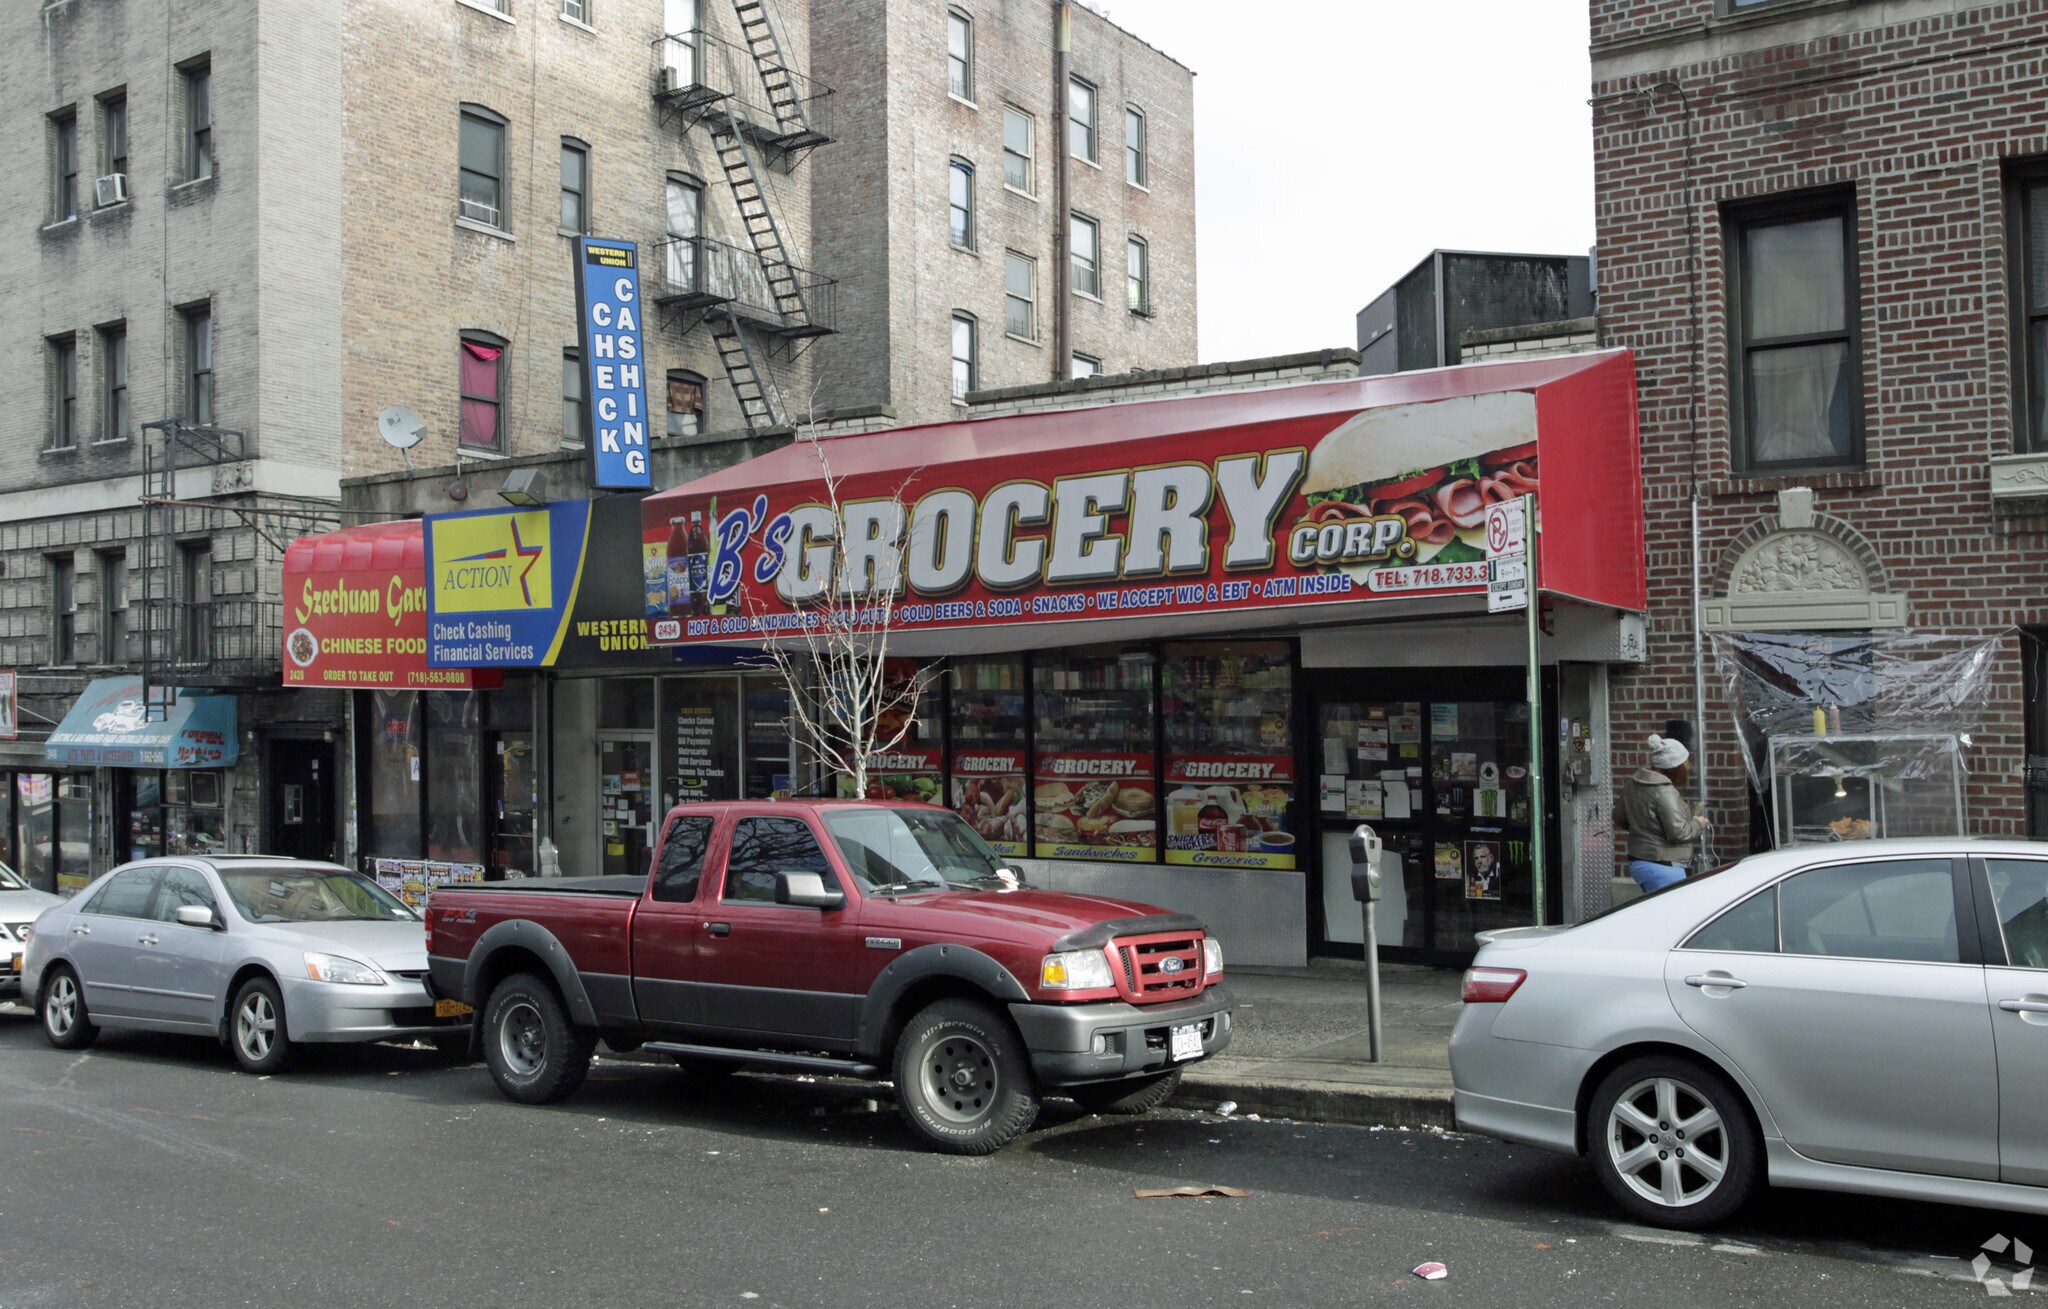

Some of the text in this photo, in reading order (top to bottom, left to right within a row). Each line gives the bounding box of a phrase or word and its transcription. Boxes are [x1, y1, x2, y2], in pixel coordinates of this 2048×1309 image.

[587, 246, 626, 257] WESTERN
[600, 257, 627, 267] UNION
[592, 302, 621, 453] CHECK
[614, 277, 646, 475] CASHING
[707, 446, 1307, 604] B's GROCERY
[1289, 516, 1415, 565] CORP.
[443, 566, 512, 590] ACTION
[1375, 567, 1487, 586] TEL: 718.733.3
[295, 577, 381, 625] Szechuan
[657, 624, 677, 637] 2434
[688, 619, 709, 636] HOT
[710, 619, 719, 634] &
[721, 617, 749, 633] COLD
[749, 611, 819, 632] SANDWICHES
[902, 606, 933, 622] COLD
[934, 602, 972, 620] BEERS
[975, 601, 985, 617] &
[988, 599, 1022, 617] SODA
[1032, 594, 1085, 615] SNACKS
[1097, 592, 1118, 610] WE
[1120, 588, 1175, 609] ACCEPT
[1176, 585, 1204, 604] WIC
[1206, 584, 1218, 602] &
[1222, 582, 1251, 600] EBT
[1262, 577, 1297, 598] ATM
[1298, 574, 1353, 595] INSIDE
[434, 620, 511, 642] Check Cashing
[576, 618, 648, 637] WESTERN
[321, 637, 427, 655] CHINESE FOOD
[434, 642, 534, 662] Financial Services
[323, 670, 347, 681] ORDER
[348, 670, 358, 682] TO
[359, 670, 378, 682] TAKE
[379, 671, 394, 682] OUT
[407, 671, 465, 685] (718)-563-0808
[865, 755, 928, 770] ROCERY
[963, 757, 1016, 772] GROCERY
[1053, 758, 1137, 775] GROCERY
[1184, 761, 1276, 778] GROCERY
[991, 843, 1017, 854] Meat
[1053, 845, 1138, 860] Sandwiches
[1192, 852, 1268, 866] Groceries
[921, 1021, 986, 1043] All-Terrain
